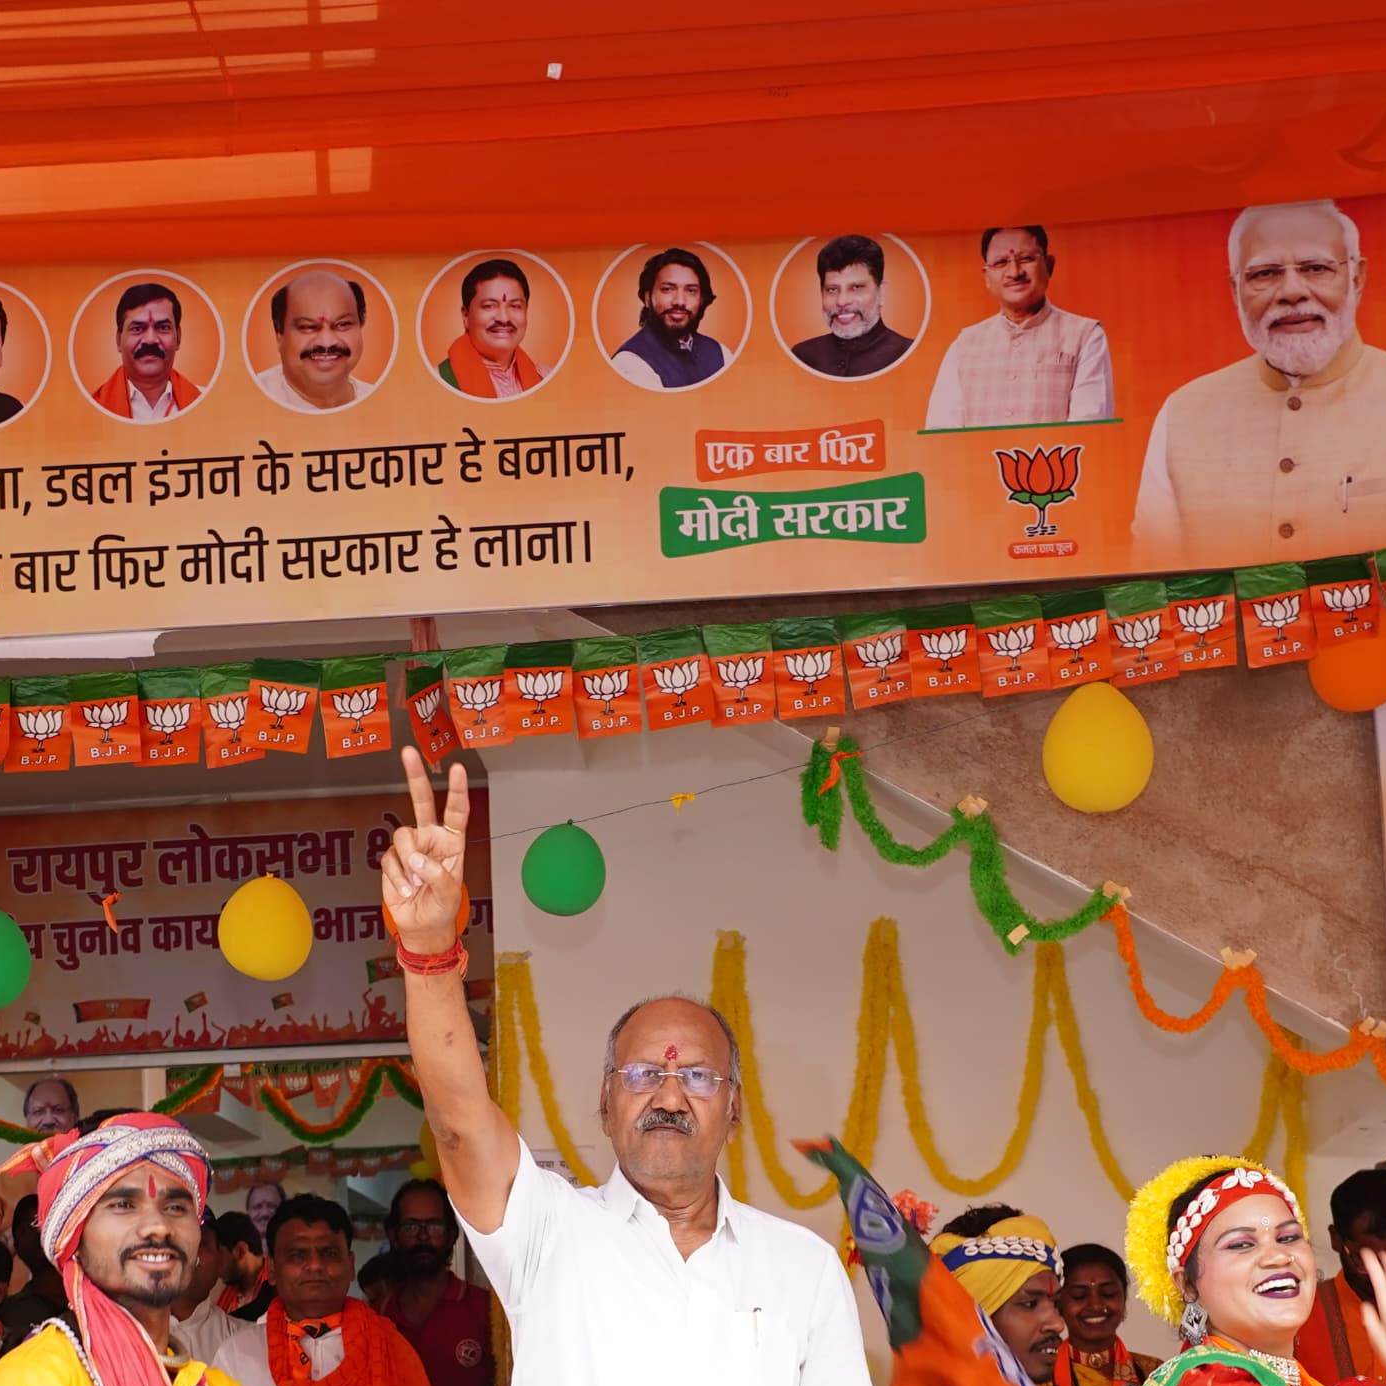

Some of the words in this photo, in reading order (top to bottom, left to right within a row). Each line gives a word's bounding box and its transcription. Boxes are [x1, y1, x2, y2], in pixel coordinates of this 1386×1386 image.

[705, 442, 755, 474] एक
[762, 442, 811, 464] बार
[819, 430, 876, 465] फिर
[42, 460, 138, 508] डबल
[145, 449, 245, 507] इंजन
[252, 440, 294, 495] के
[301, 442, 447, 492] सरकार
[451, 427, 486, 484] हे
[494, 431, 634, 482] बनाना,
[675, 495, 760, 542] मोदी
[770, 497, 910, 537] सरकार
[10, 549, 80, 594] बार
[88, 533, 169, 591] फिर
[177, 526, 269, 587] मोदी
[277, 529, 423, 580] सरकार
[429, 514, 462, 571] हे
[1183, 648, 1226, 663] B.J.P.
[1263, 642, 1305, 657] B.J.P.
[1060, 663, 1101, 679] B.J.P.
[1125, 663, 1167, 679] B.J.P.
[929, 674, 970, 688] B.J.P.
[997, 672, 1039, 687] B.J.P.
[868, 681, 910, 698] B.J.P.
[725, 704, 765, 718] B.J.P.
[793, 697, 834, 710] B.J.P.
[664, 705, 704, 721] B.J.P.
[522, 716, 562, 729] B.J.P.
[591, 716, 631, 730] B.J.P.
[258, 731, 297, 744] B.J.P.
[464, 726, 504, 740] B.J.P.
[342, 734, 381, 748] B.J.P.
[90, 745, 130, 759] B.J.P.
[149, 746, 188, 760] B.J.P.
[20, 754, 59, 766] B.J.P.
[6, 840, 147, 906] रायपुर
[151, 823, 356, 886] लोकसभा
[50, 918, 143, 971] चुनाव
